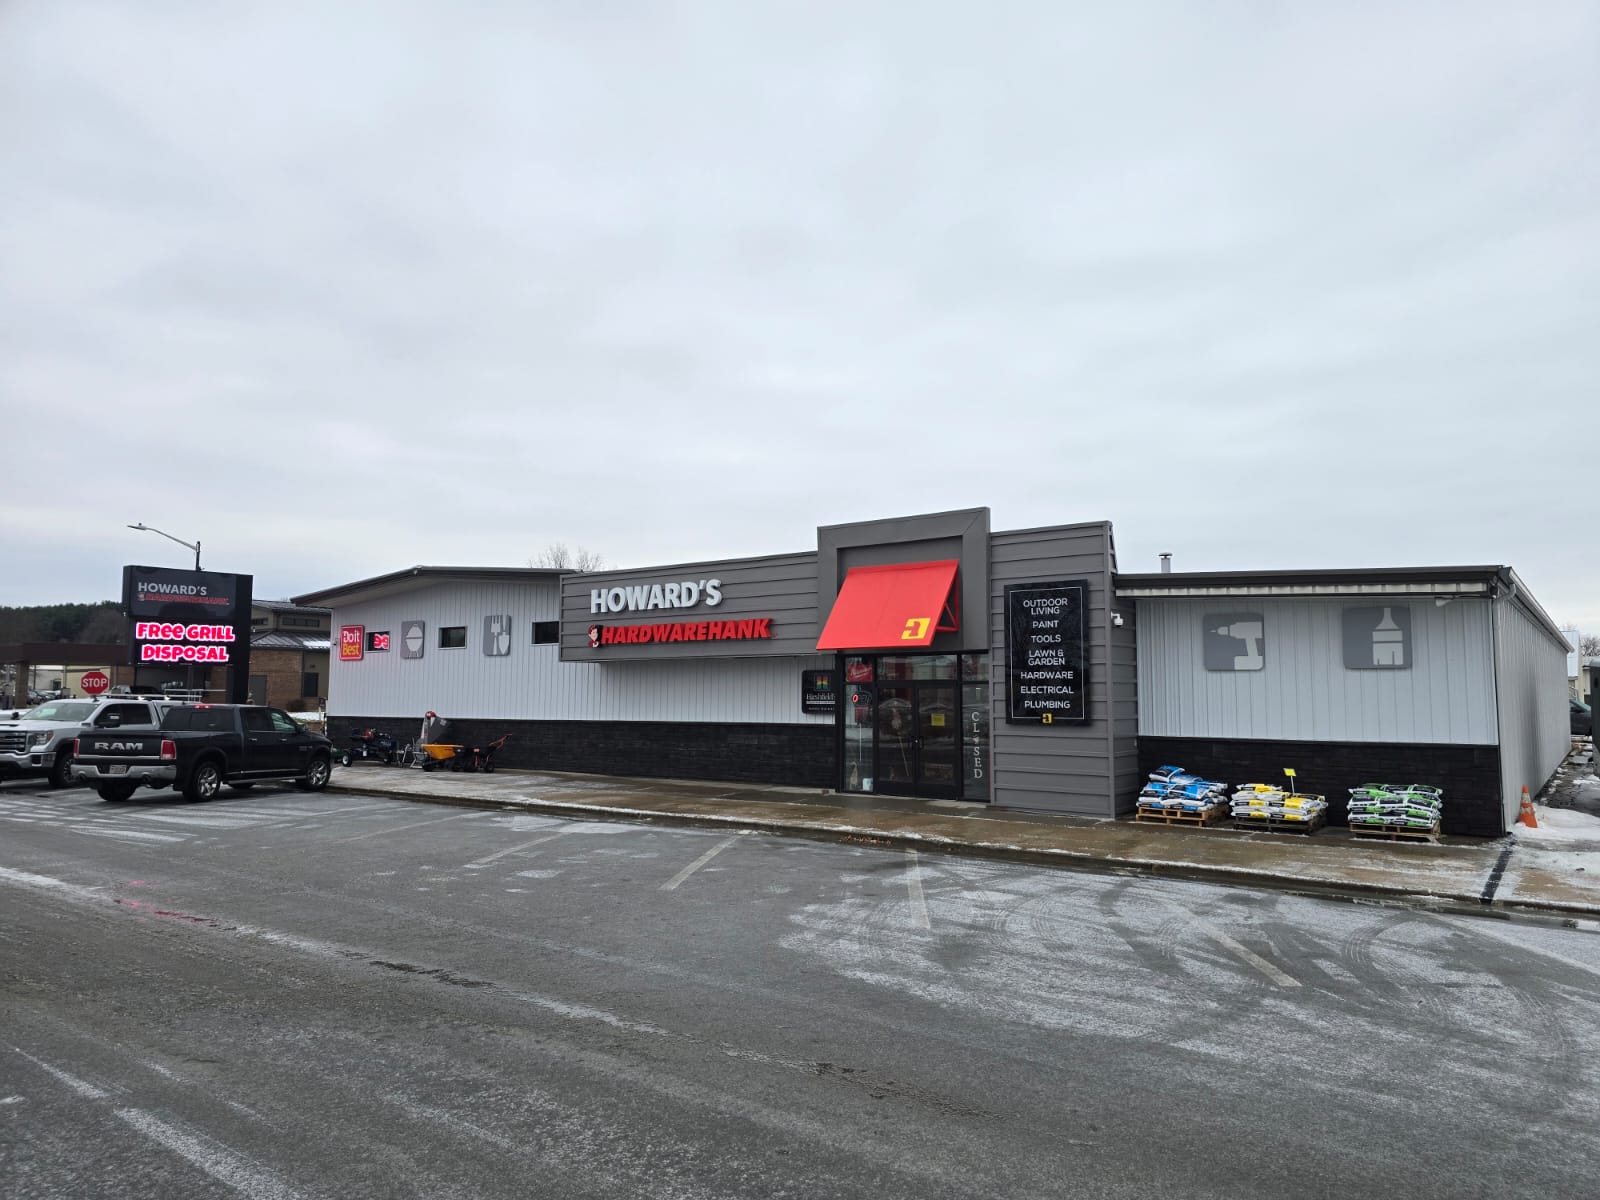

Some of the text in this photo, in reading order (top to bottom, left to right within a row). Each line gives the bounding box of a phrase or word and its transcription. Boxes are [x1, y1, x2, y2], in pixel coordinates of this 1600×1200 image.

[138, 582, 208, 596] HOWARD'S
[590, 579, 722, 614] HOWARD'S
[1023, 598, 1068, 608] OUTDOOR
[1031, 606, 1060, 615] LIVING
[1032, 620, 1059, 628] PAINT
[186, 624, 235, 642] GRILL
[601, 618, 771, 645] HARDWAREHANK
[1031, 634, 1061, 643] TOOLS
[142, 644, 229, 662] DISPOSAL
[342, 643, 360, 656] Best
[1029, 649, 1064, 658] LAWN &
[1028, 657, 1065, 666] GARDEN
[1020, 671, 1073, 680] HARDWARE
[82, 678, 107, 688] STOP
[1020, 686, 1074, 694] ELECTRICAL
[1024, 700, 1071, 709] PLUMBING
[94, 742, 144, 751] RAM
